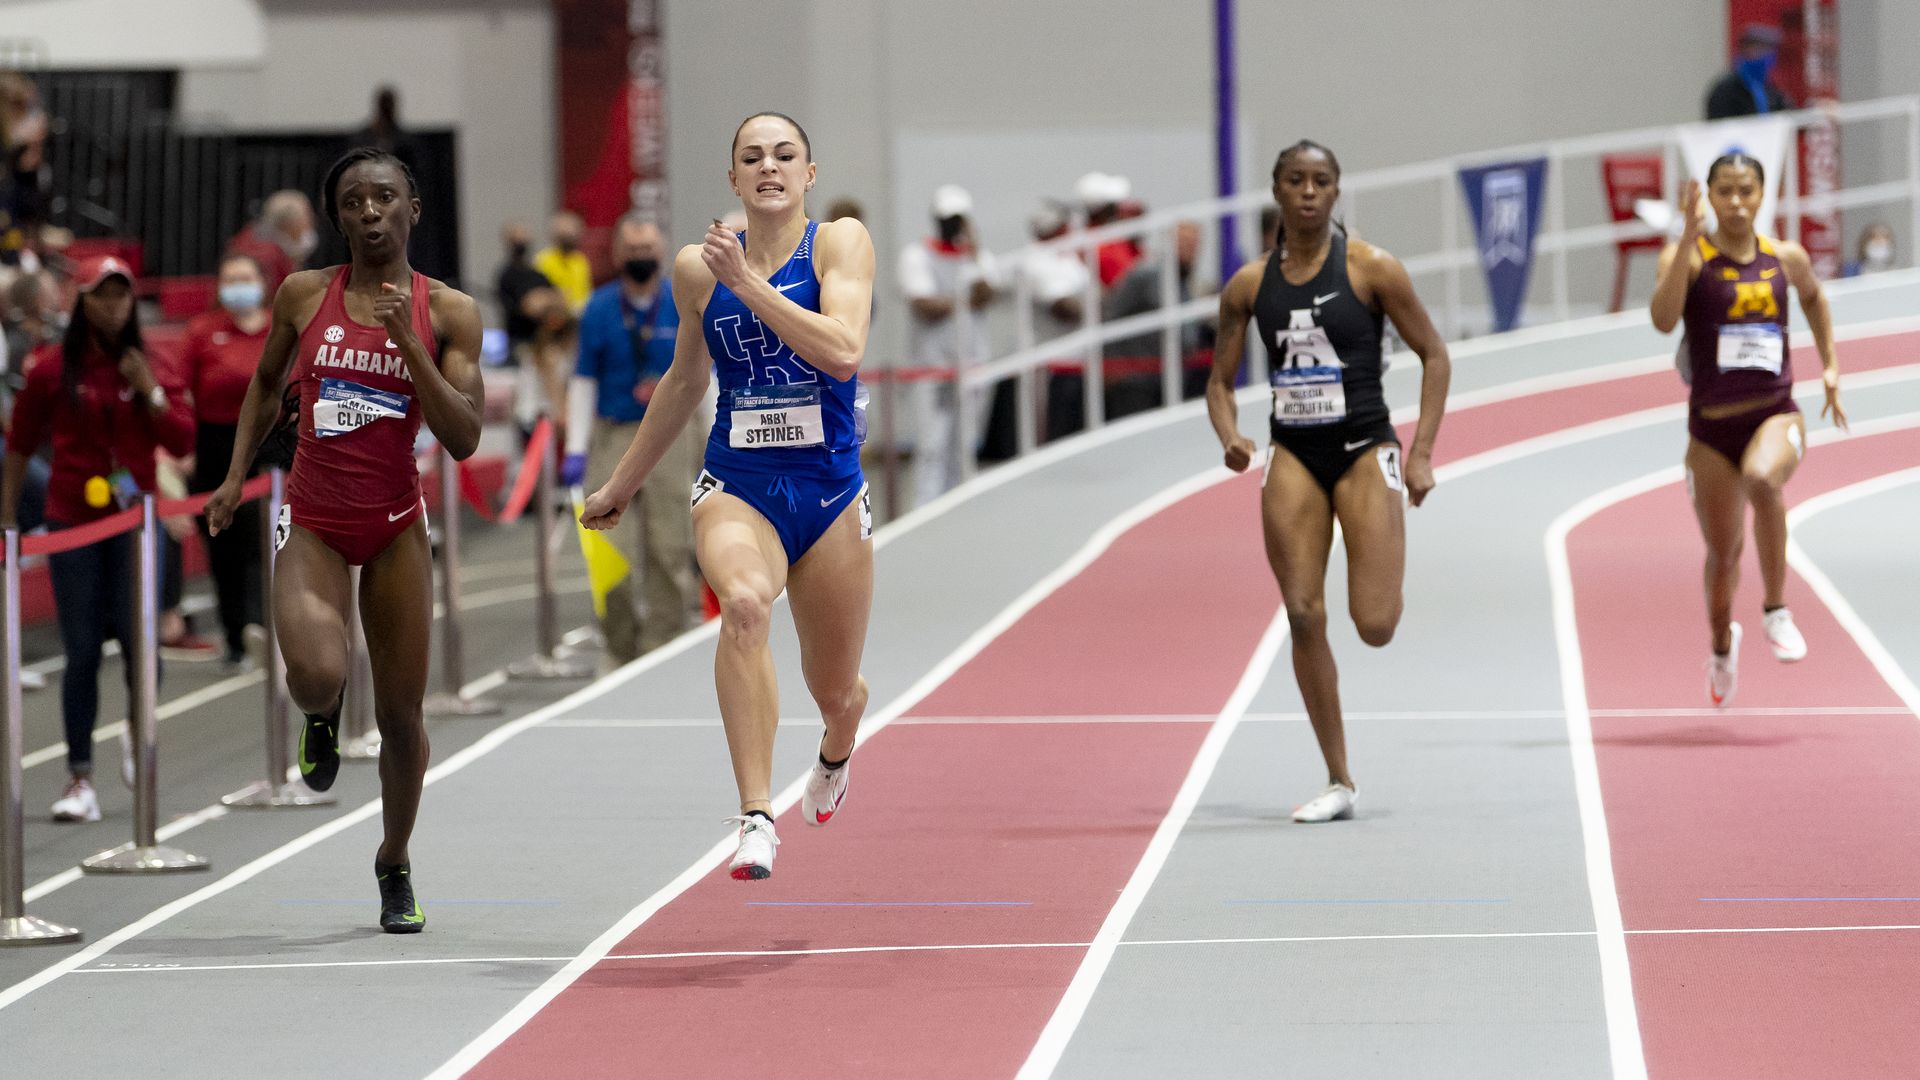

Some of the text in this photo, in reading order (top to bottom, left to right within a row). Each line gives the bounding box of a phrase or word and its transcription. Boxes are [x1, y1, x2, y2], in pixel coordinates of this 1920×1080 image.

[314, 344, 413, 383] ALABAMA
[760, 412, 787, 426] ABBY
[746, 426, 804, 443] STEINER
